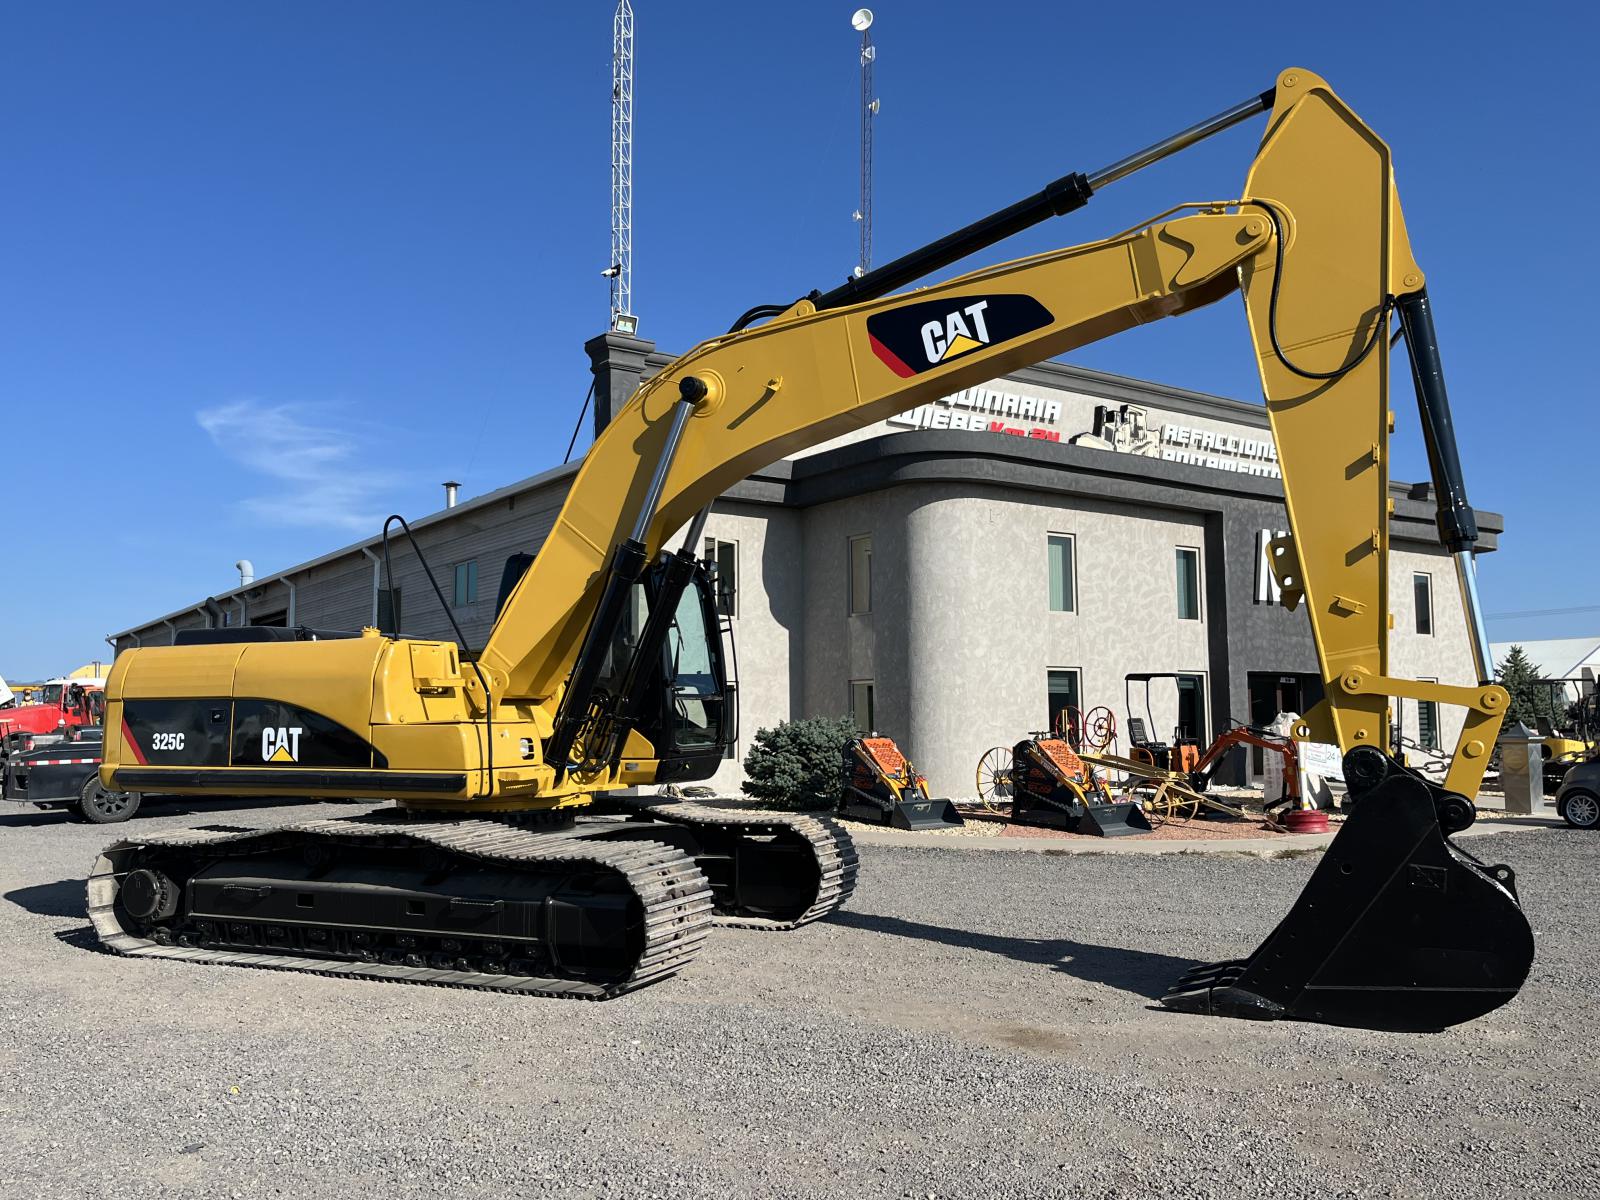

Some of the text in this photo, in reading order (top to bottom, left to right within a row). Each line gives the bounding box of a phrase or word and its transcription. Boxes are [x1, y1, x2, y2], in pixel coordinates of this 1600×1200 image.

[921, 300, 990, 364] CAT
[152, 732, 185, 750] 325C
[262, 727, 303, 762] CAT
